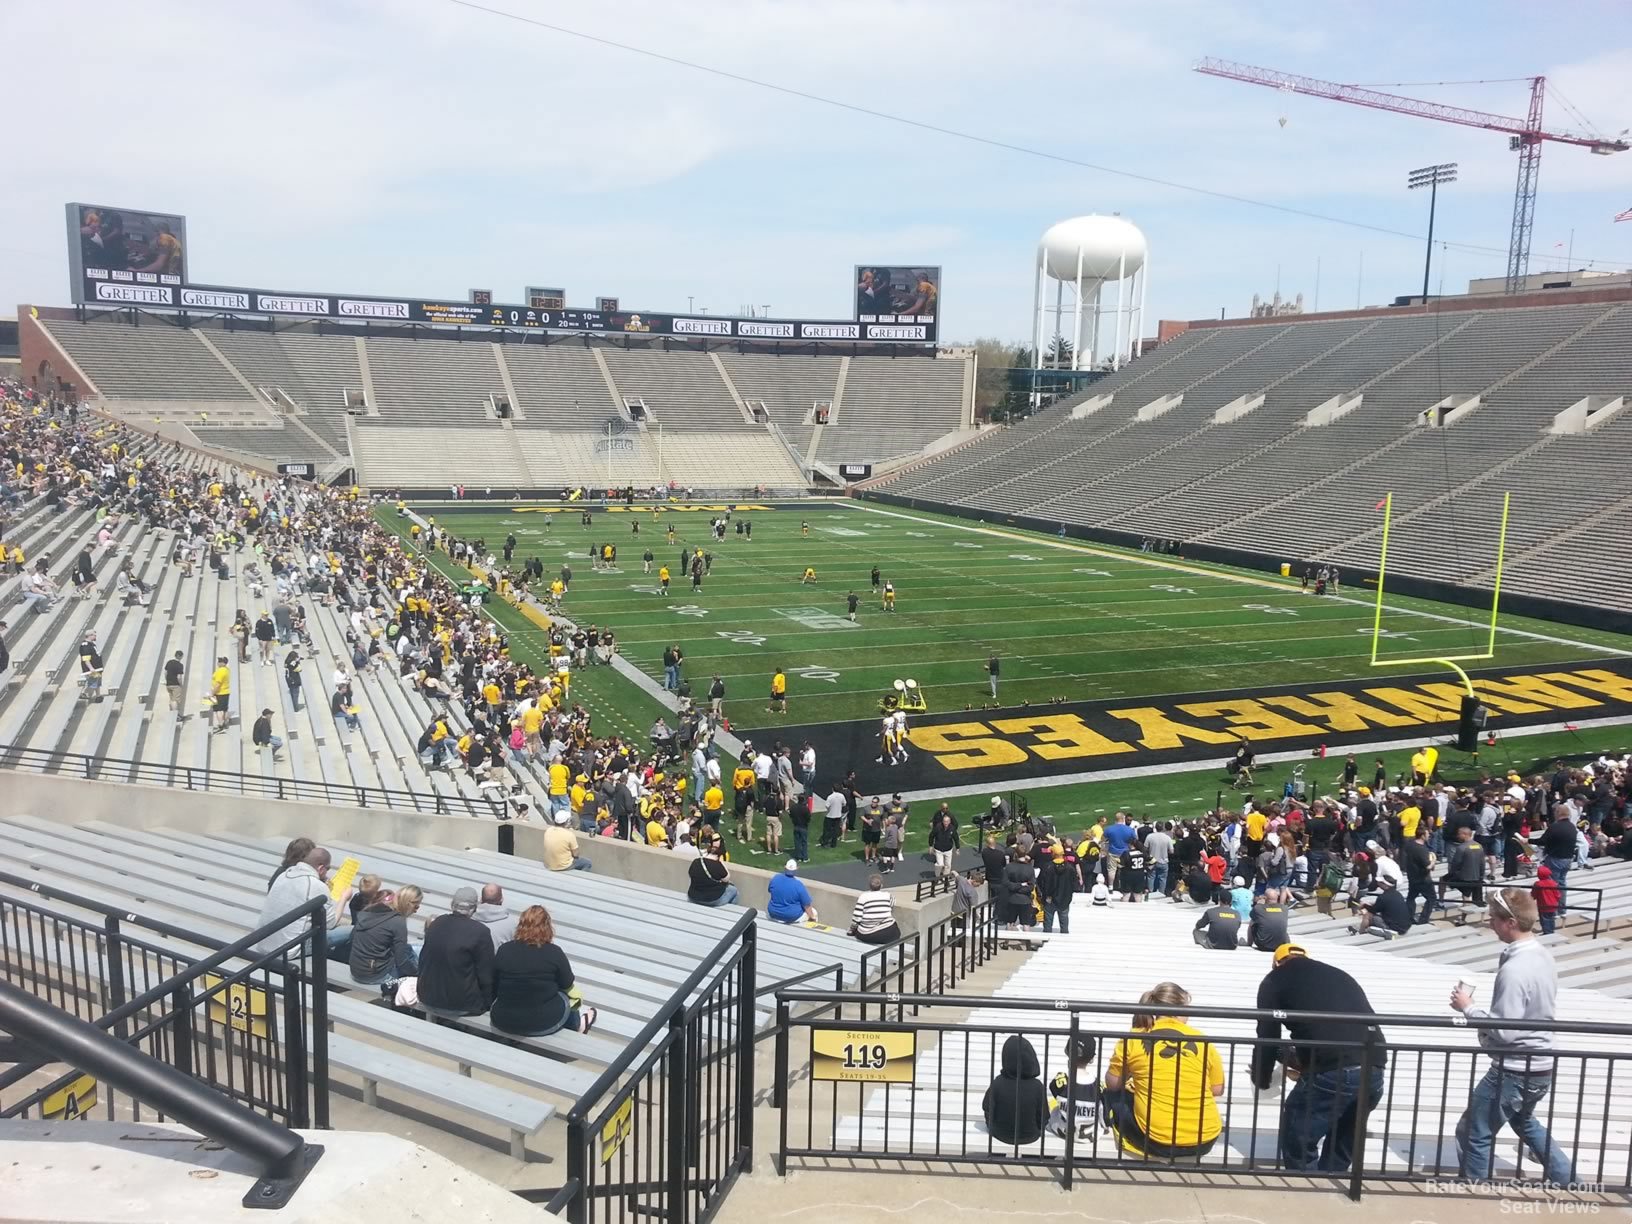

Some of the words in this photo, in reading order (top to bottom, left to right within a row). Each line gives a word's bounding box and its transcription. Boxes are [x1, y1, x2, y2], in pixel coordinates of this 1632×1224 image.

[99, 284, 169, 302] GRETTER
[183, 290, 246, 308] GRETTER
[476, 293, 489, 304] 25
[260, 297, 326, 312] GRETTER
[340, 302, 406, 316] GRETTER
[603, 300, 616, 312] 25
[511, 311, 519, 321] 0
[542, 313, 550, 323] 0
[674, 320, 729, 333] GRETTER
[740, 323, 791, 336] GRETTER
[803, 326, 857, 337] GRETTER
[869, 327, 923, 338] GRETTER
[667, 604, 709, 615] 30
[715, 630, 768, 643] 20
[786, 664, 840, 679] 10
[1132, 858, 1144, 869] 32
[844, 1044, 887, 1069] 119
[64, 1092, 79, 1120] A
